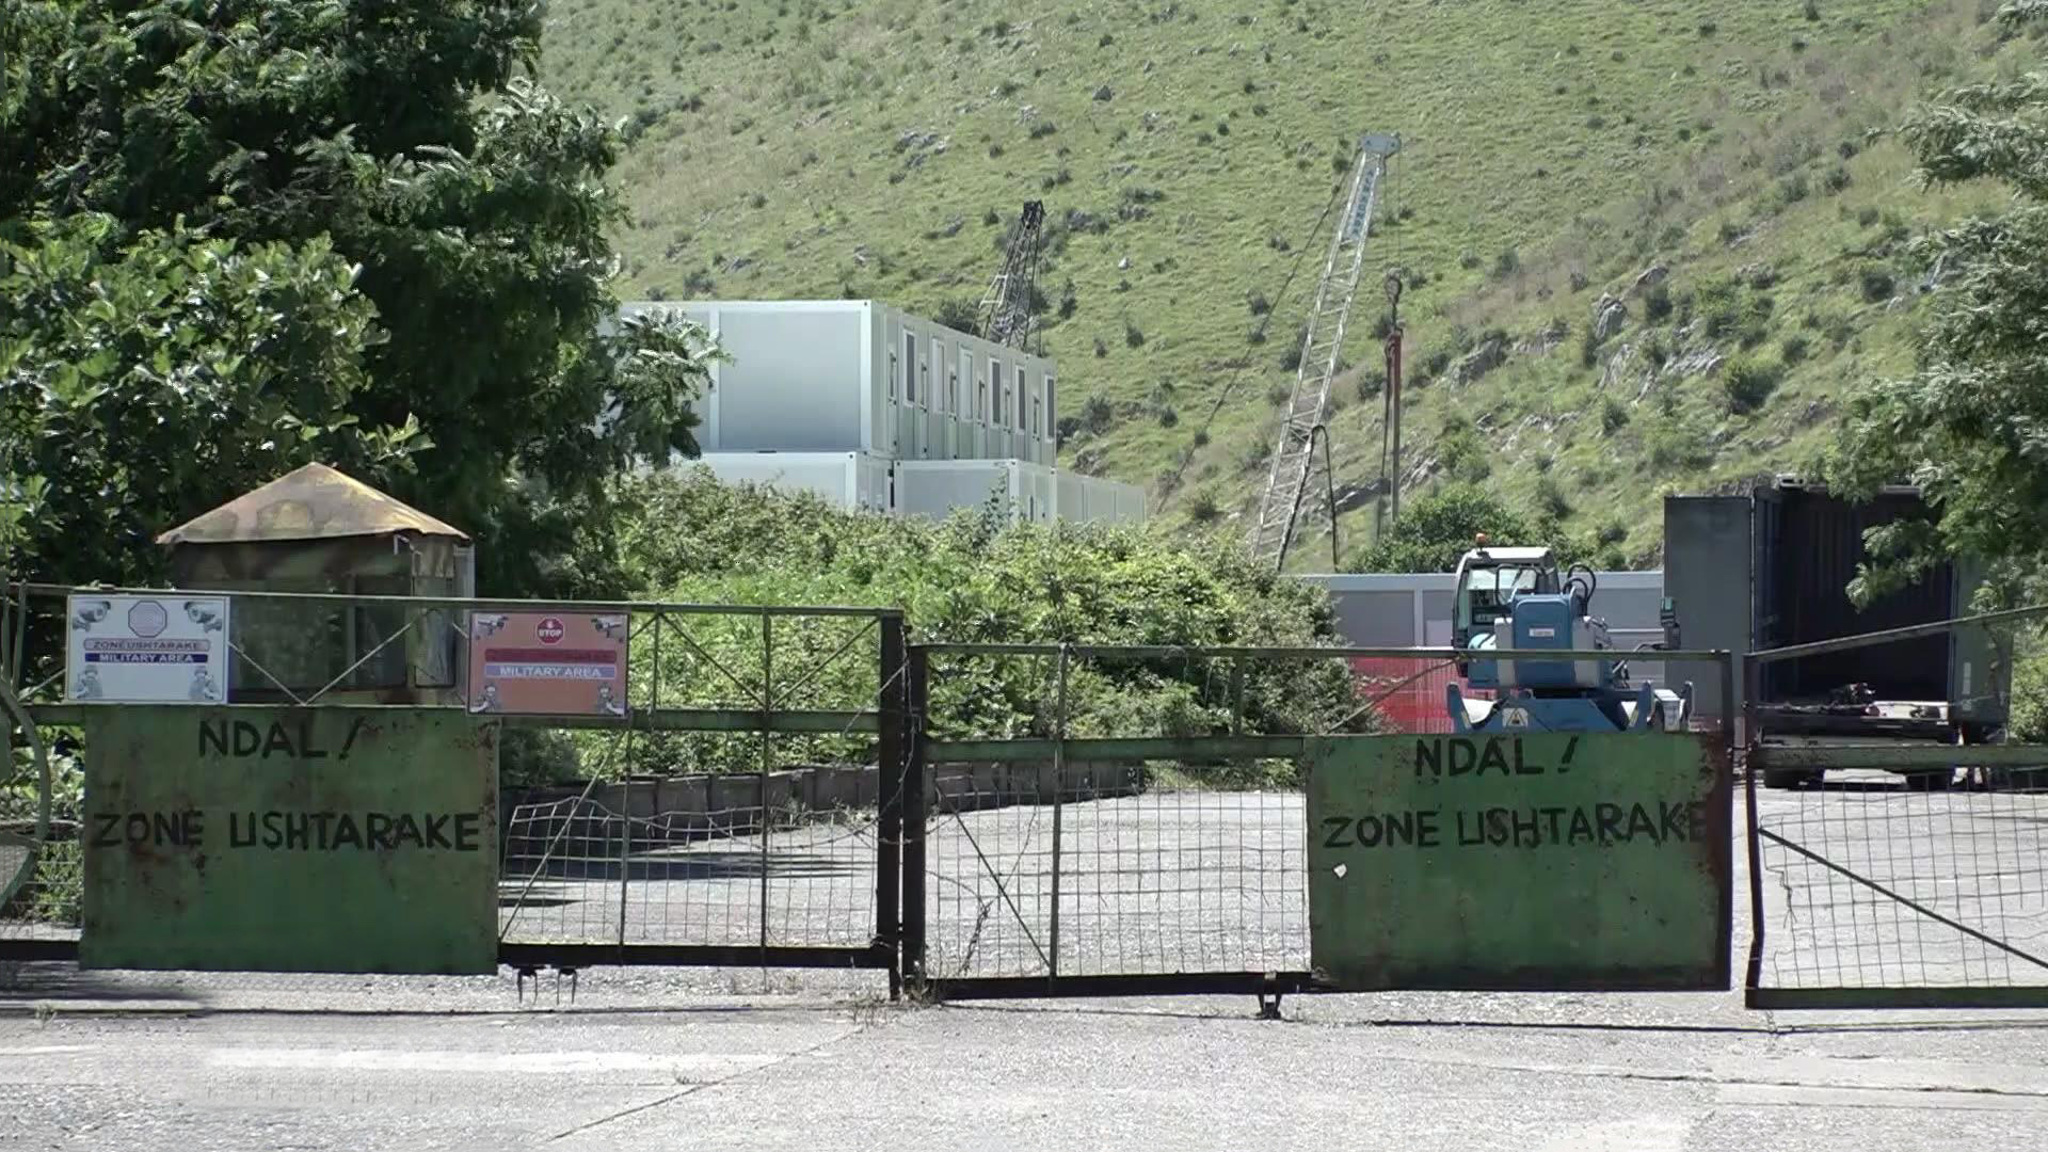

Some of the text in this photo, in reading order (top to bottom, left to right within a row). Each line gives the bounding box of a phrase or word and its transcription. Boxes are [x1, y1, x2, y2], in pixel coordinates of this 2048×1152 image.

[538, 628, 563, 638] STOP
[99, 653, 194, 664] MILITARY AREA
[499, 666, 602, 678] MILITARY AREA
[93, 810, 480, 851] ZONE USHTARAKE
[1322, 801, 1709, 849] ZONE USHTARAKE
